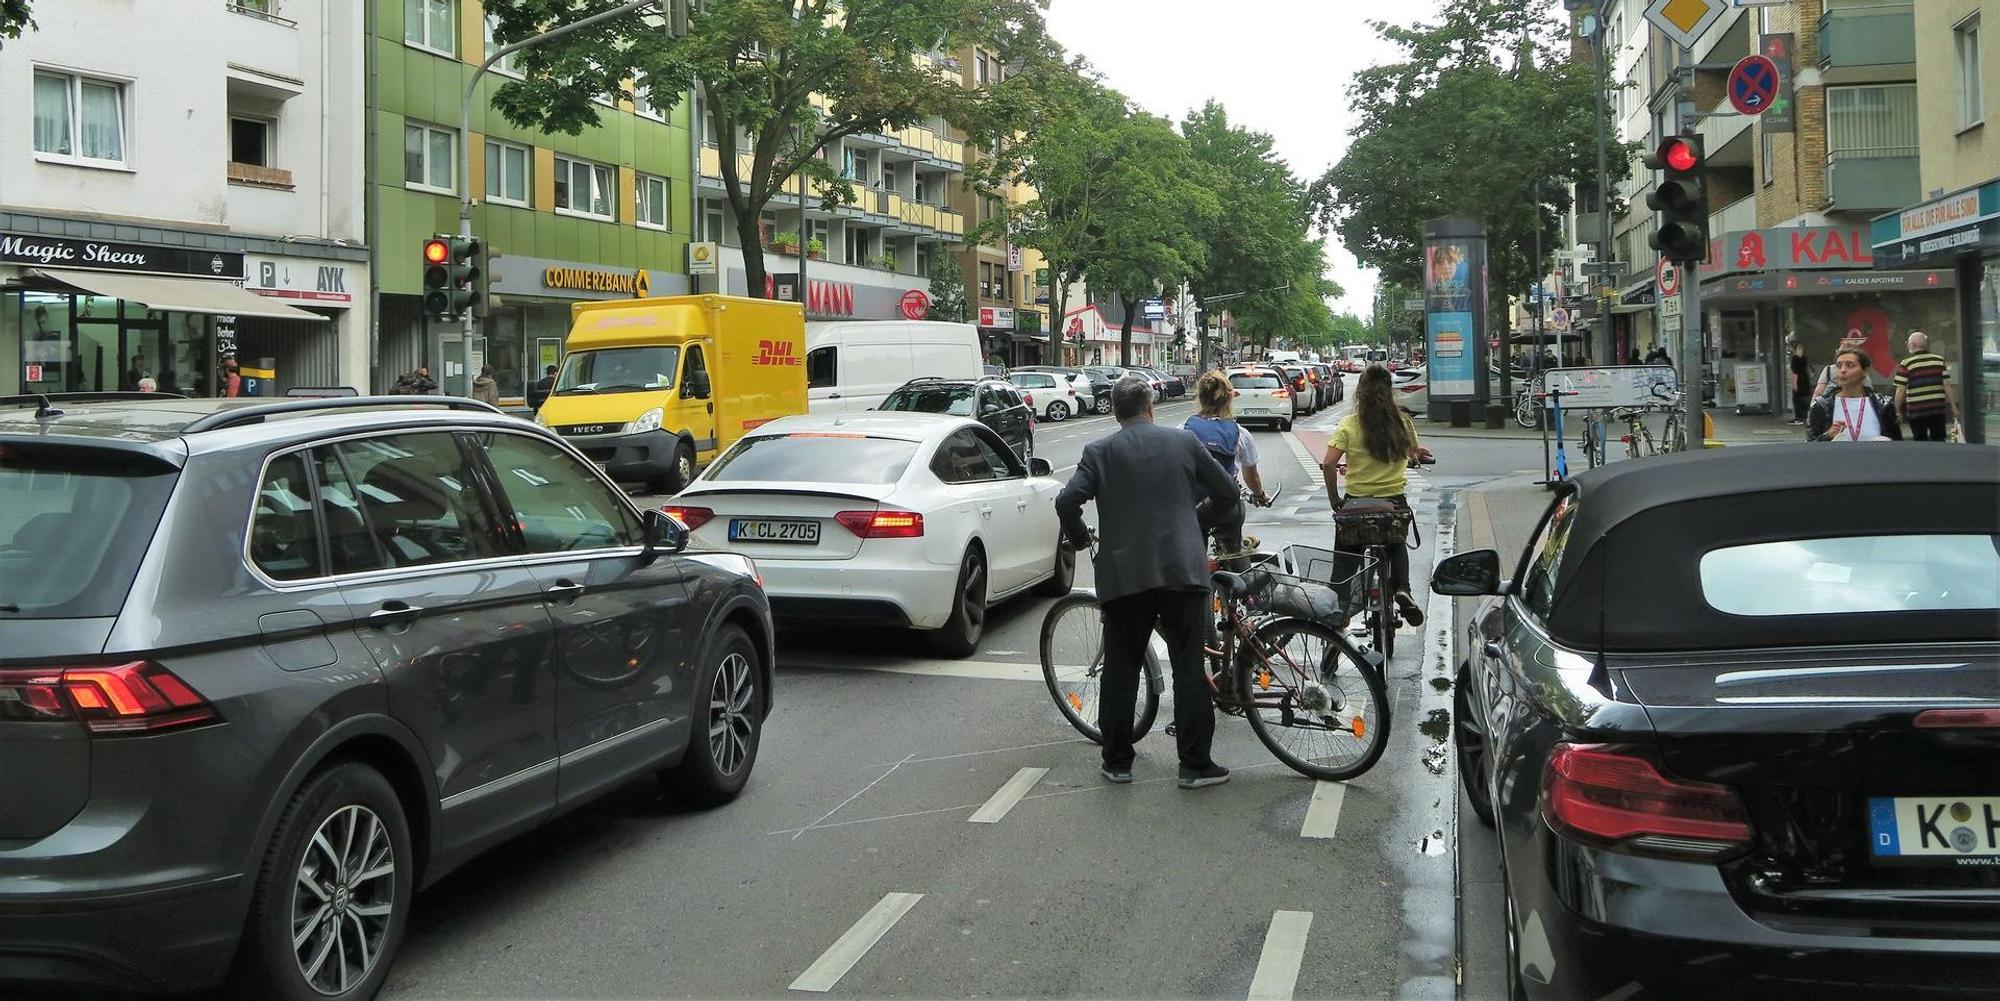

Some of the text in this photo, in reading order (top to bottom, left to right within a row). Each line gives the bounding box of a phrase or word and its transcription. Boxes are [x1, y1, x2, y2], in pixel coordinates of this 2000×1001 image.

[0, 236, 147, 265] Magic Shear
[263, 265, 272, 285] P
[317, 266, 345, 292] AYK
[545, 267, 636, 293] COMMERZBANK
[1870, 276, 1904, 284] APOTHEKE
[758, 339, 796, 366] DHL
[248, 379, 256, 393] P
[573, 425, 603, 433] IVECO
[738, 522, 817, 539] K CL 2705
[1917, 803, 1951, 849] K
[1880, 833, 1891, 846] D
